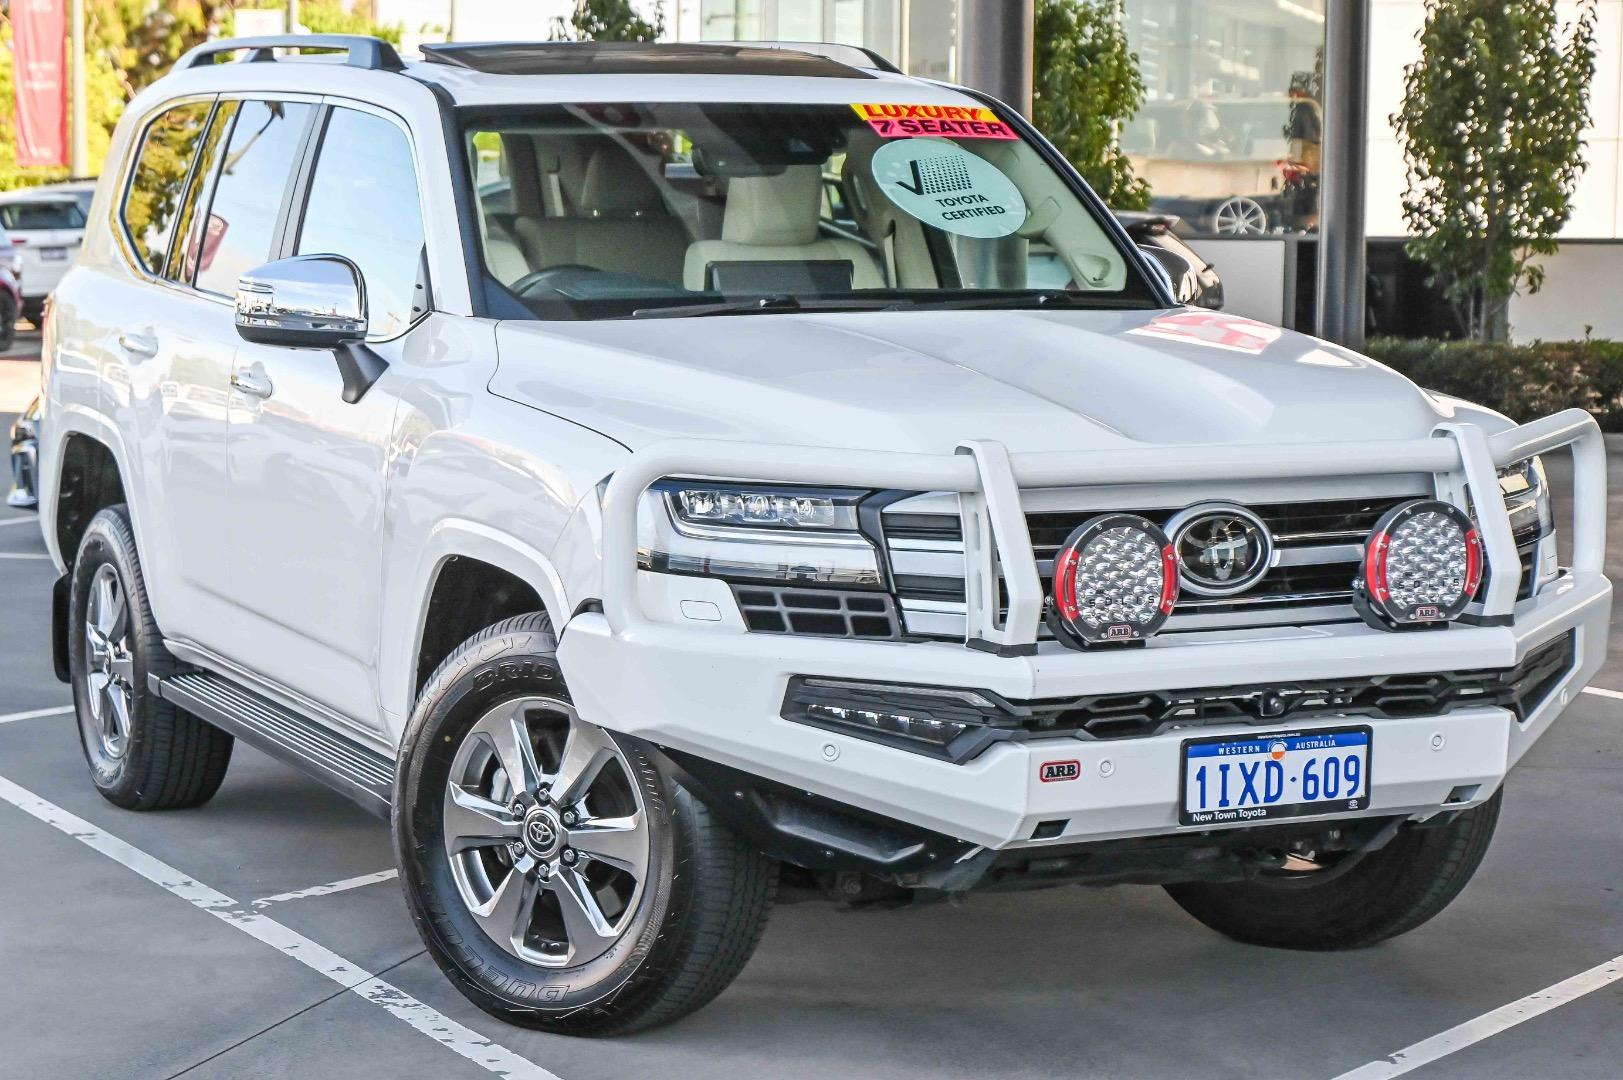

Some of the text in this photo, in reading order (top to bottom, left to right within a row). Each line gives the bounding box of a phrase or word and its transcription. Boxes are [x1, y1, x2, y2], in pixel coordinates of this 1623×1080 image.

[863, 104, 982, 120] LUXURY
[871, 119, 1009, 135] 7 SEATER
[935, 194, 989, 208] TOYOTA
[941, 205, 1006, 221] CERTIFIED
[1218, 739, 1336, 755] WESTERN AUSTRALIA
[1045, 764, 1076, 778] ARB
[1193, 808, 1267, 822] New Town Toyota
